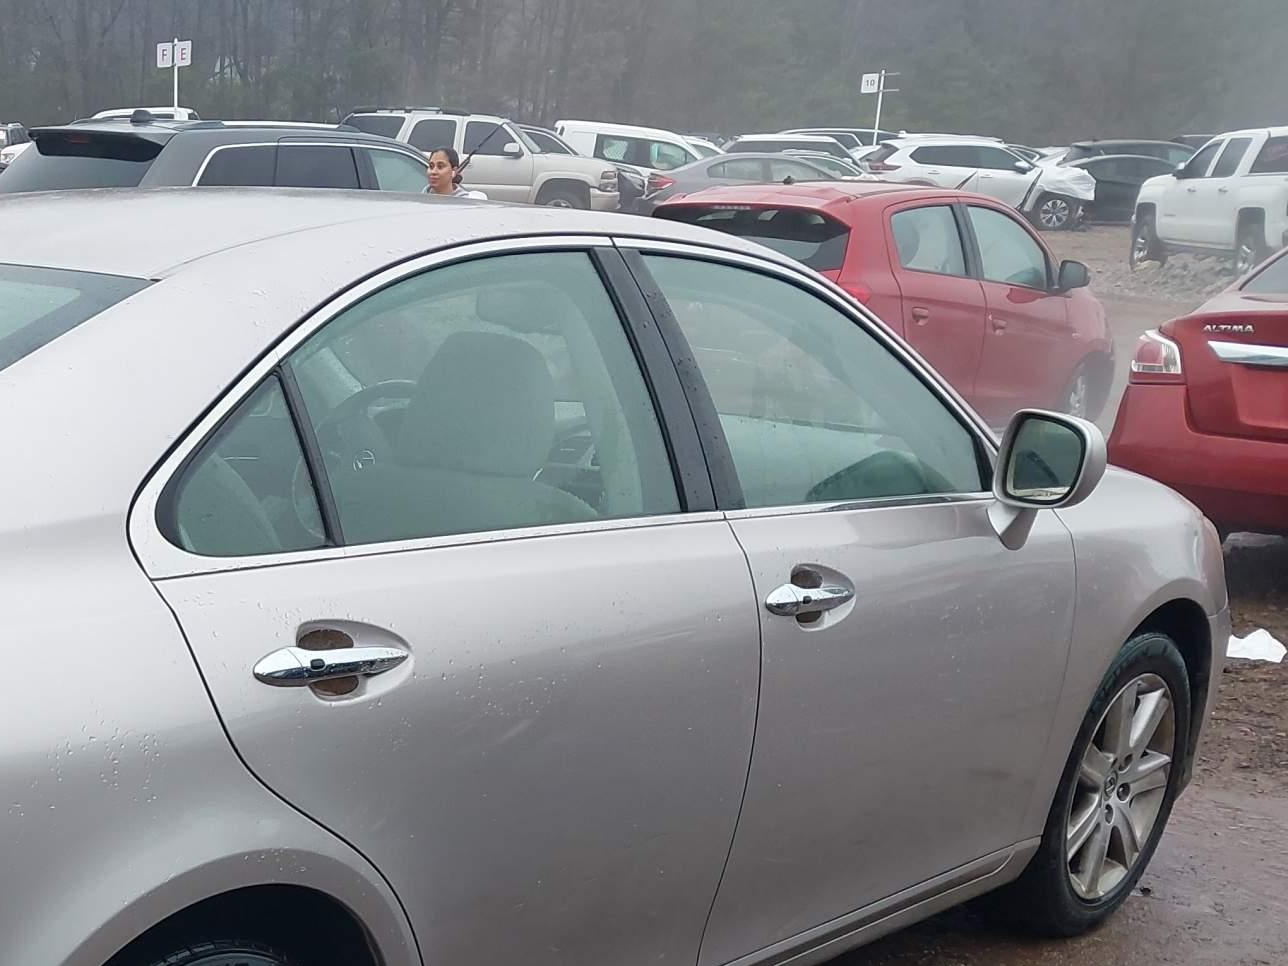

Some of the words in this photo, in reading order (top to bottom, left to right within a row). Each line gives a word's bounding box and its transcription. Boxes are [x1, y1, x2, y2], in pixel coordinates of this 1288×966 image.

[161, 48, 168, 62] F
[180, 47, 187, 61] E
[866, 79, 876, 87] 10
[1203, 324, 1255, 333] ALTIMA
